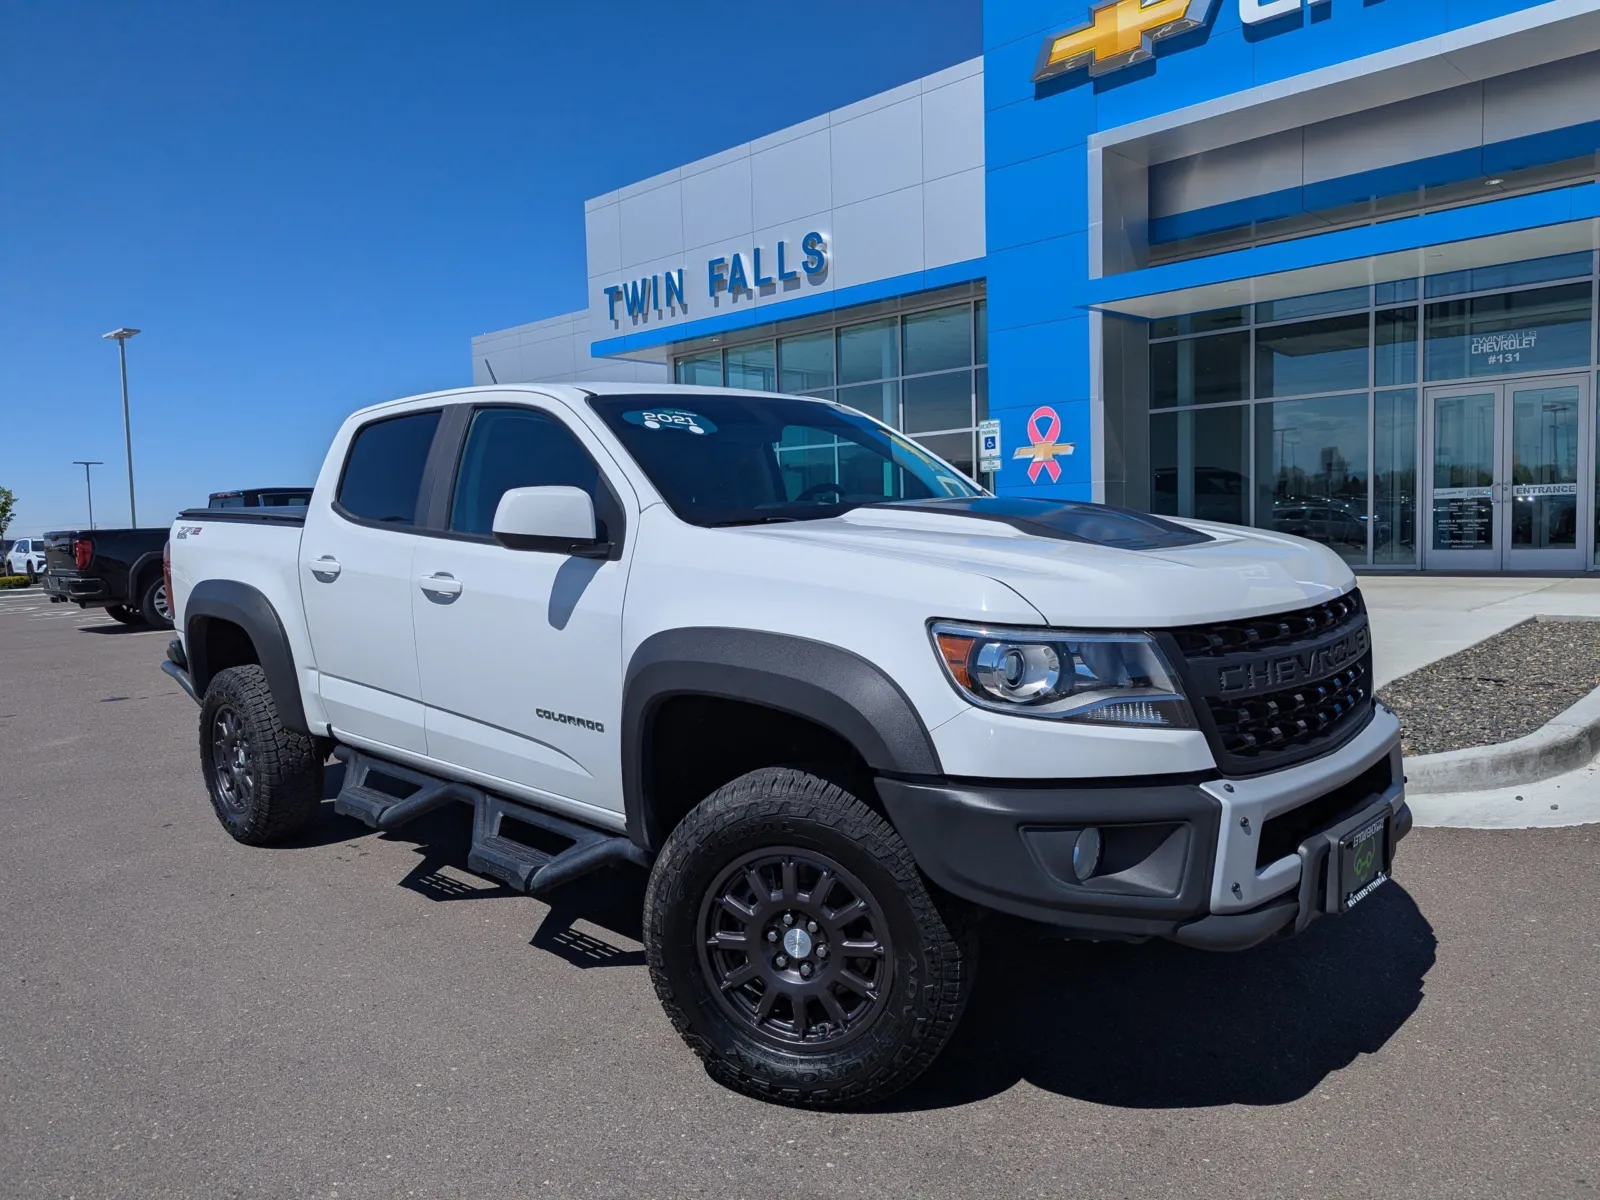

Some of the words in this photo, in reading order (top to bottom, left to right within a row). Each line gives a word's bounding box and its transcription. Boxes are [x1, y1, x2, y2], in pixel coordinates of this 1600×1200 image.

[603, 268, 685, 321] TWIN
[708, 231, 828, 298] FALLS
[1471, 337, 1536, 354] CHEVROLET
[1488, 352, 1520, 364] #131
[642, 412, 697, 426] 2021
[1516, 486, 1576, 499] ENTRANCE
[536, 708, 605, 734] COLORADO
